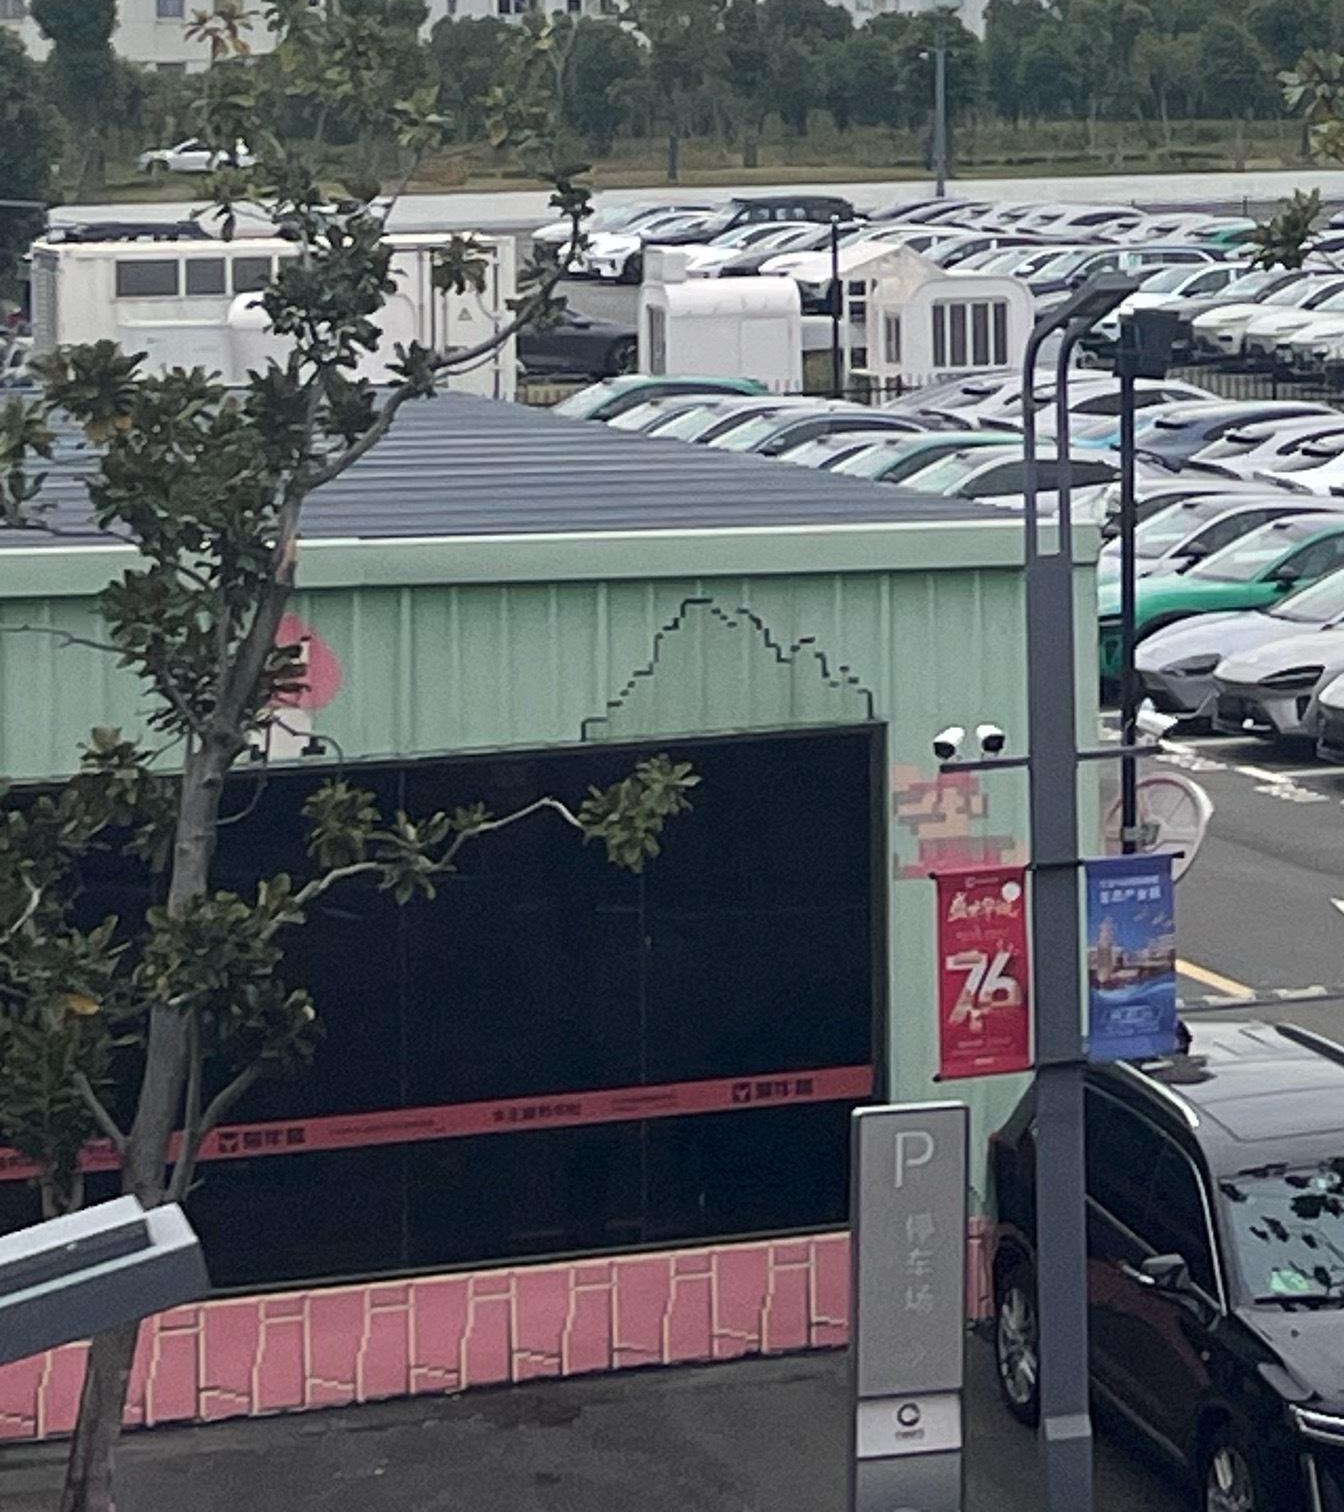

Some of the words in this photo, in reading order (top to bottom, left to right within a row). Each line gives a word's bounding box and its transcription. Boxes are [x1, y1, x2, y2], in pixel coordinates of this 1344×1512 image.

[945, 948, 1022, 1025] 76
[895, 1131, 934, 1188] P
[904, 1213, 935, 1315] 停车场
